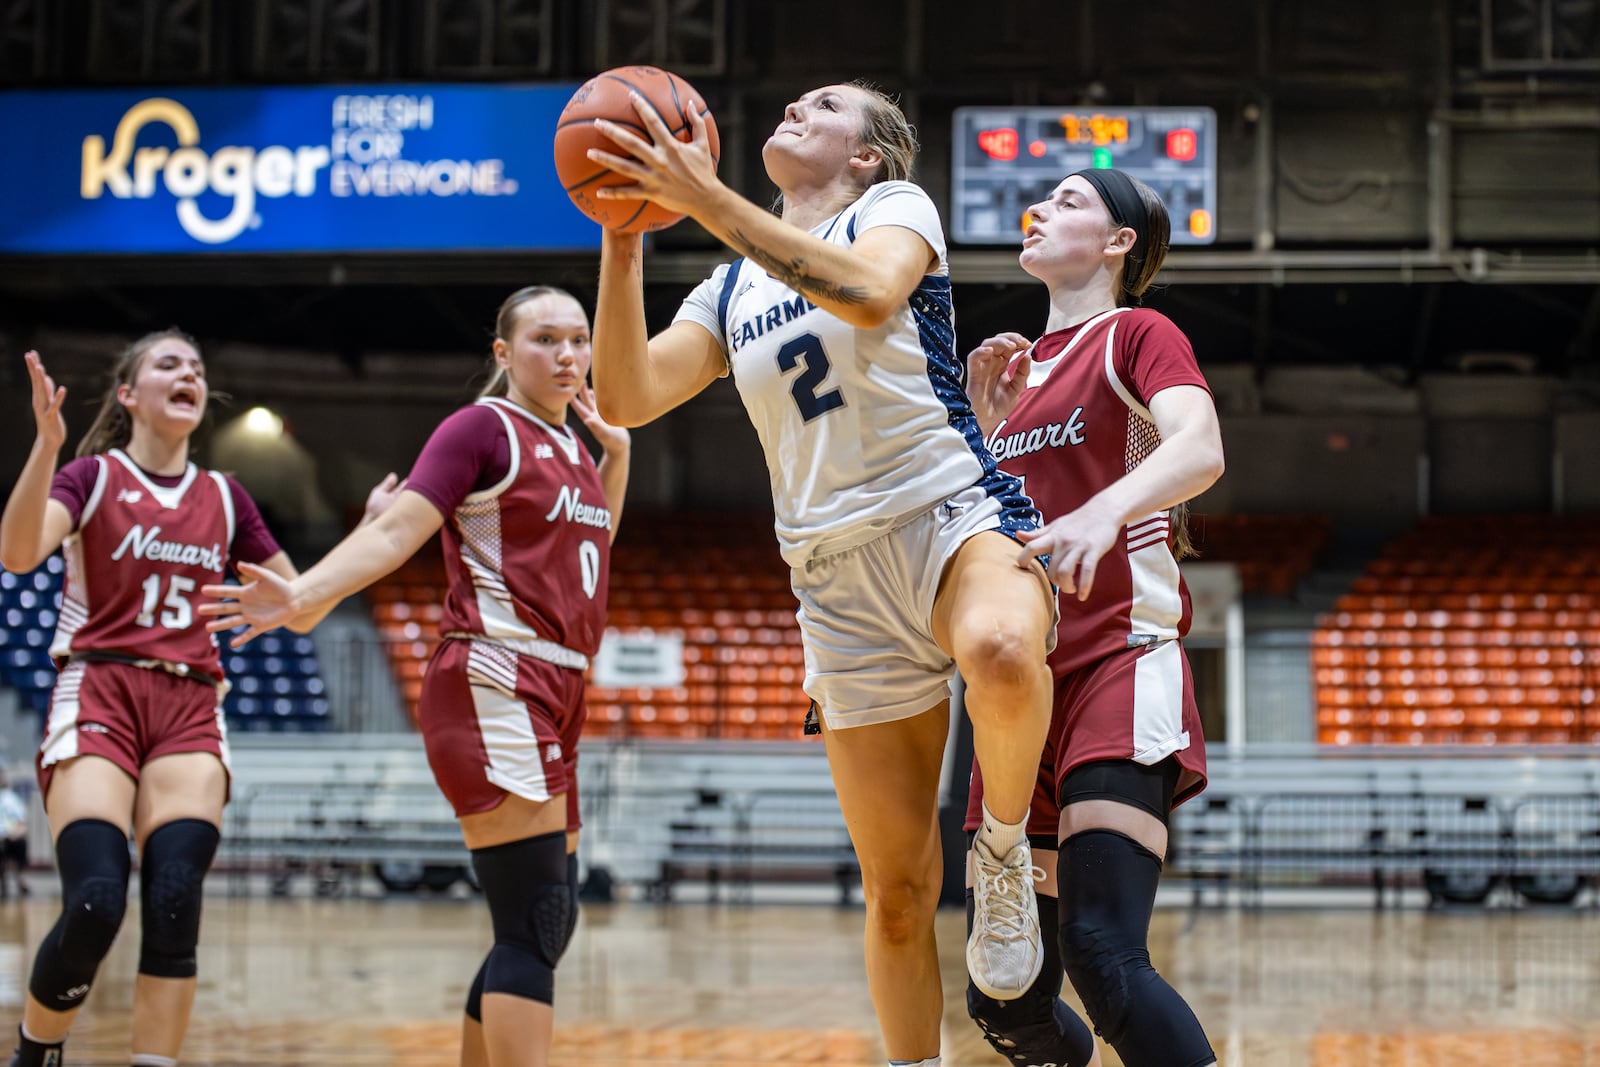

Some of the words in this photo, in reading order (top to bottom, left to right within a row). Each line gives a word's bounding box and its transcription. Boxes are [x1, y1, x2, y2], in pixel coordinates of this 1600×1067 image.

[332, 94, 434, 131] FRESH
[80, 97, 331, 244] Kroger
[332, 128, 404, 164] FOR
[731, 296, 818, 353] FAIRM
[775, 330, 848, 426] 2
[545, 484, 612, 532] Newar
[111, 523, 222, 573] Newark
[578, 539, 600, 600] 0
[135, 573, 196, 629] 15
